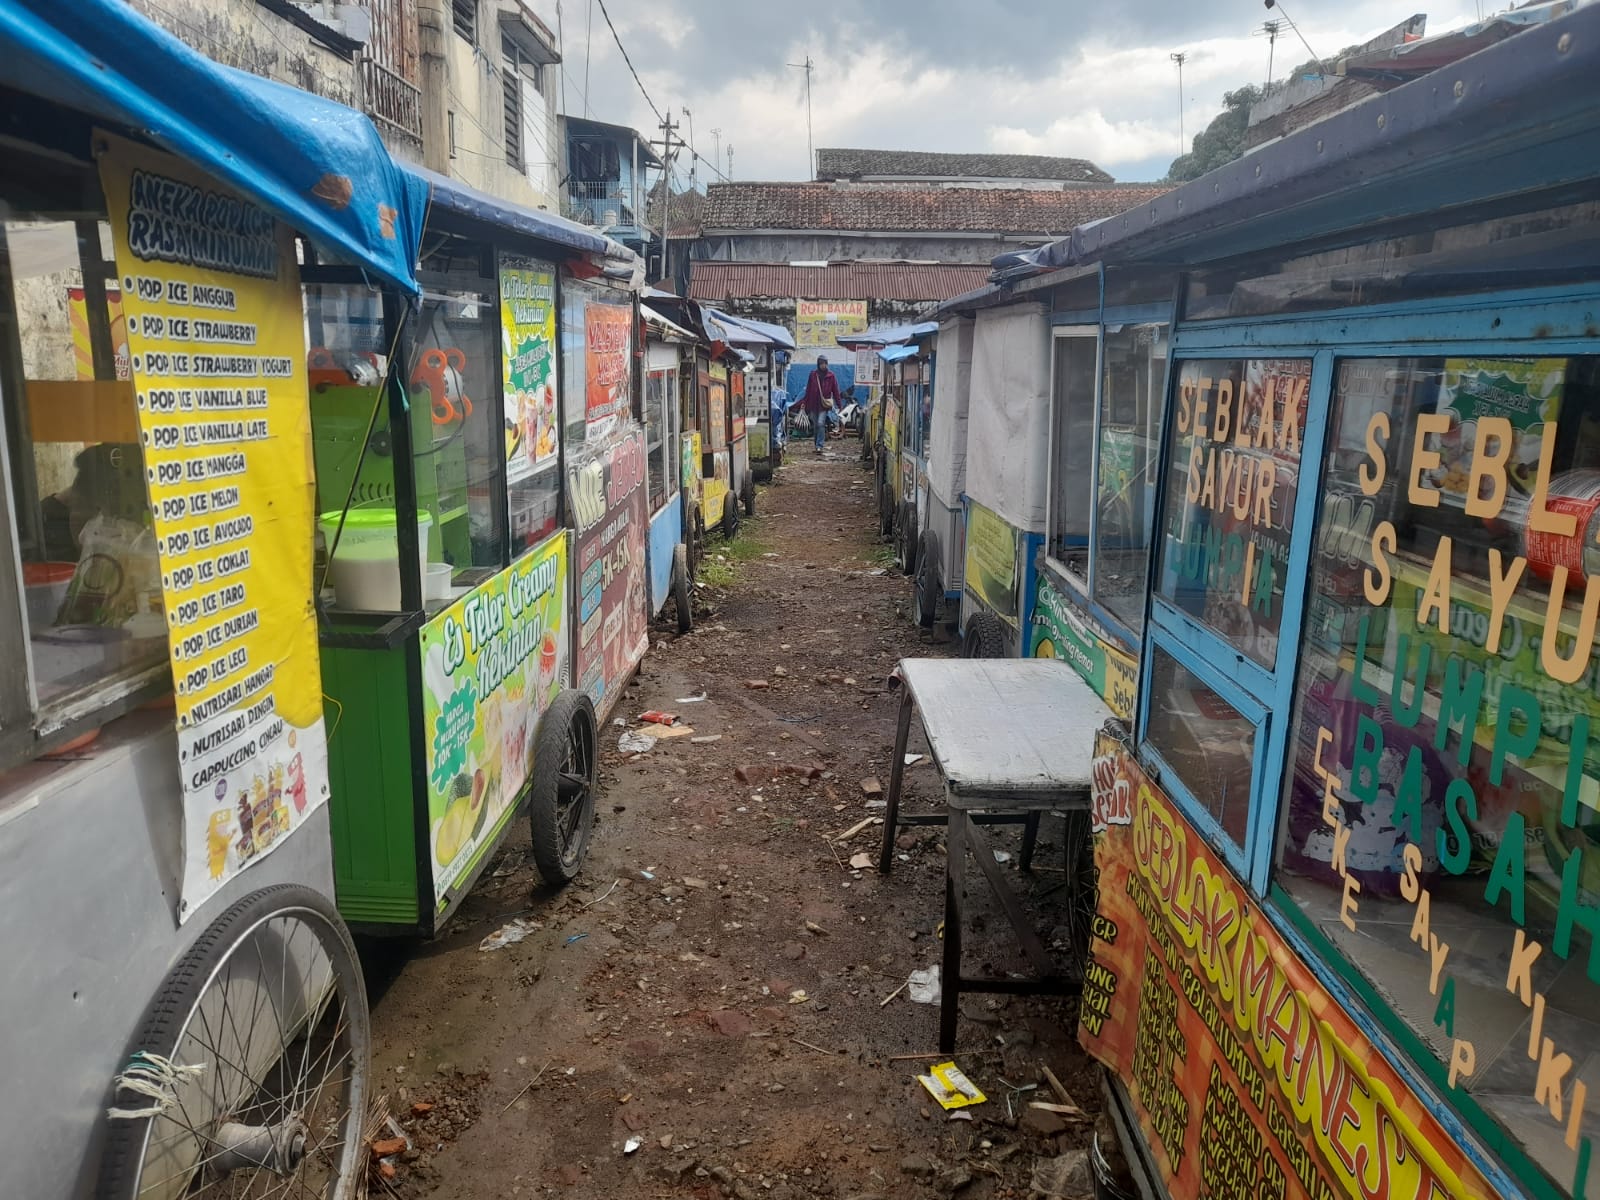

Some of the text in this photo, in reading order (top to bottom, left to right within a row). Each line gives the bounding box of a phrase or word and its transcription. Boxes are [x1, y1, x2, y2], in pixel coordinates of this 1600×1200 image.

[137, 277, 236, 308] POP ICE ANGGUR
[800, 303, 863, 315] ROTI BAKAR
[142, 316, 256, 343] POP ICE STRAWBERRY
[146, 355, 169, 374] POP
[172, 356, 188, 374] ICE
[193, 357, 258, 375] STRAWBERRY
[260, 359, 292, 375] YOGURT
[149, 389, 267, 409] POP ICE VANILLA BLUE
[1177, 375, 1308, 454] SEBLAK
[153, 420, 267, 446] POP ICE VANILLA LATE
[158, 463, 182, 483] POP
[187, 460, 205, 477] ICE
[1188, 446, 1277, 528] SAYUR
[1359, 410, 1600, 542] SEBL
[163, 487, 239, 519] POP ICE MELON
[168, 516, 252, 553] POP ICE AVOCADO
[172, 548, 250, 589] POP ICE COKLAT
[1170, 511, 1274, 618] LUMPIA
[177, 584, 245, 623] POP ICE TARO
[443, 615, 465, 677] Es
[464, 590, 506, 656] Teler
[507, 551, 559, 620] Creamy
[183, 610, 258, 658] POP ICE DURIAN
[475, 613, 542, 704] Kekinian
[187, 647, 247, 692] POP ICE LECI
[191, 664, 274, 724] NUTRISARI HANGAT
[192, 694, 275, 758] NUTRISARI DINGIN
[1350, 614, 1590, 829] LUMPI
[192, 740, 256, 789] CAPPUCCINO
[1350, 713, 1600, 986] BASAH
[1136, 796, 1235, 988] SEBLAK
[1400, 843, 1476, 1090] SAYAP
[1210, 1062, 1262, 1160] KWETIAU
